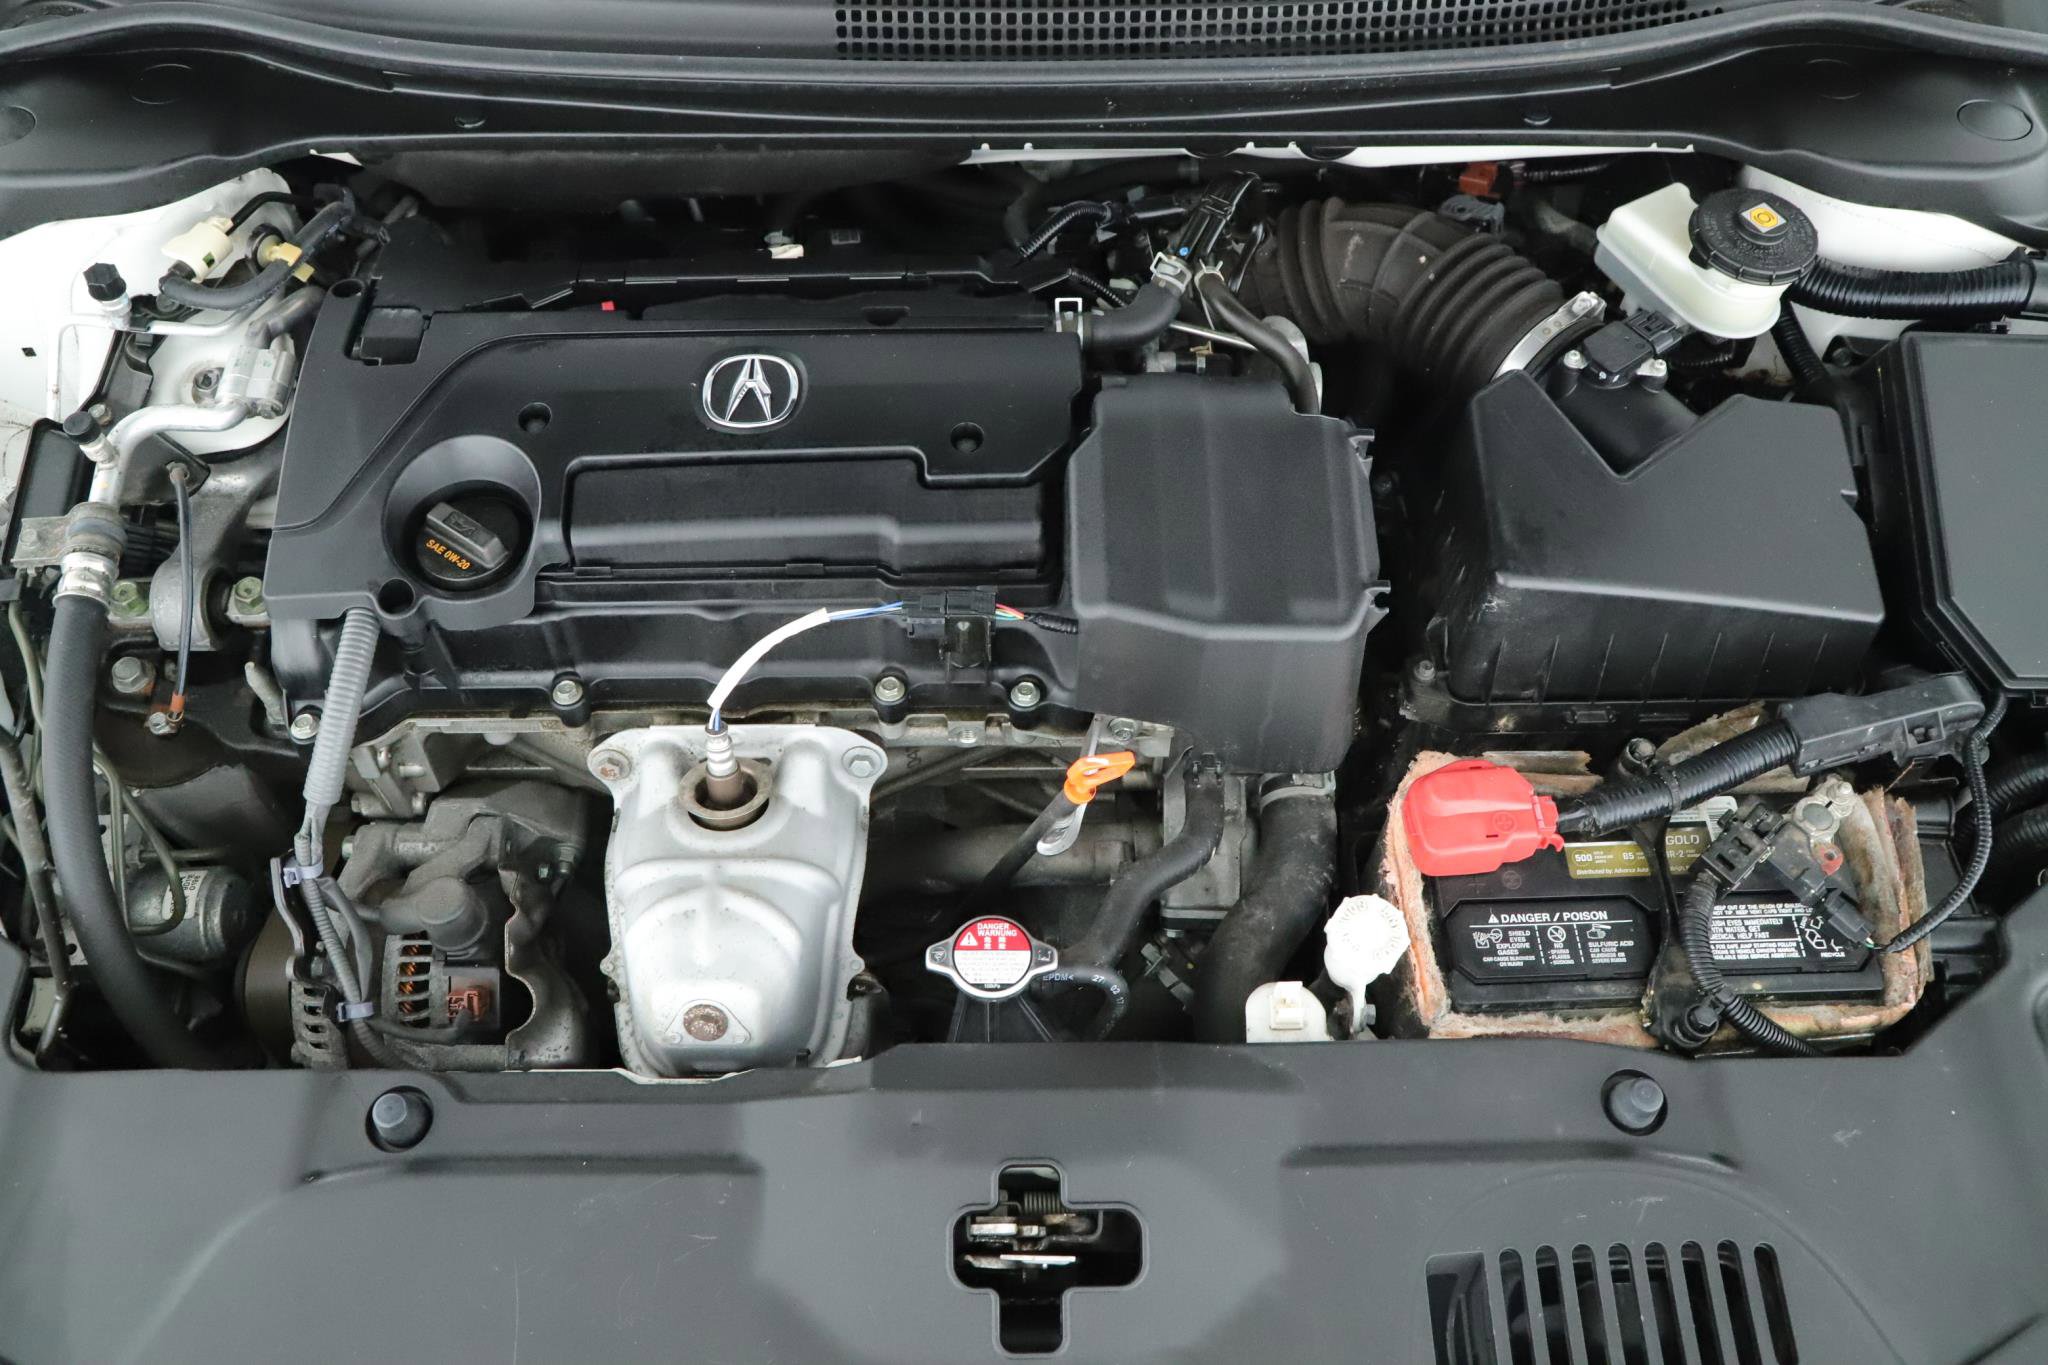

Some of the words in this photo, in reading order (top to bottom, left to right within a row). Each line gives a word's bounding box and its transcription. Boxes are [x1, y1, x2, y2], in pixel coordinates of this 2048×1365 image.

[426, 539, 447, 554] SAE
[444, 550, 470, 570] 0W-20
[1665, 834, 1700, 845] GOLD
[1574, 853, 1593, 862] 500
[1501, 913, 1551, 923] DANGER
[1563, 911, 1608, 921] POISON
[977, 922, 1010, 930] DANGER
[1748, 925, 1760, 933] GET
[977, 929, 1018, 937] WARNUNG
[1753, 931, 1769, 939] FAST
